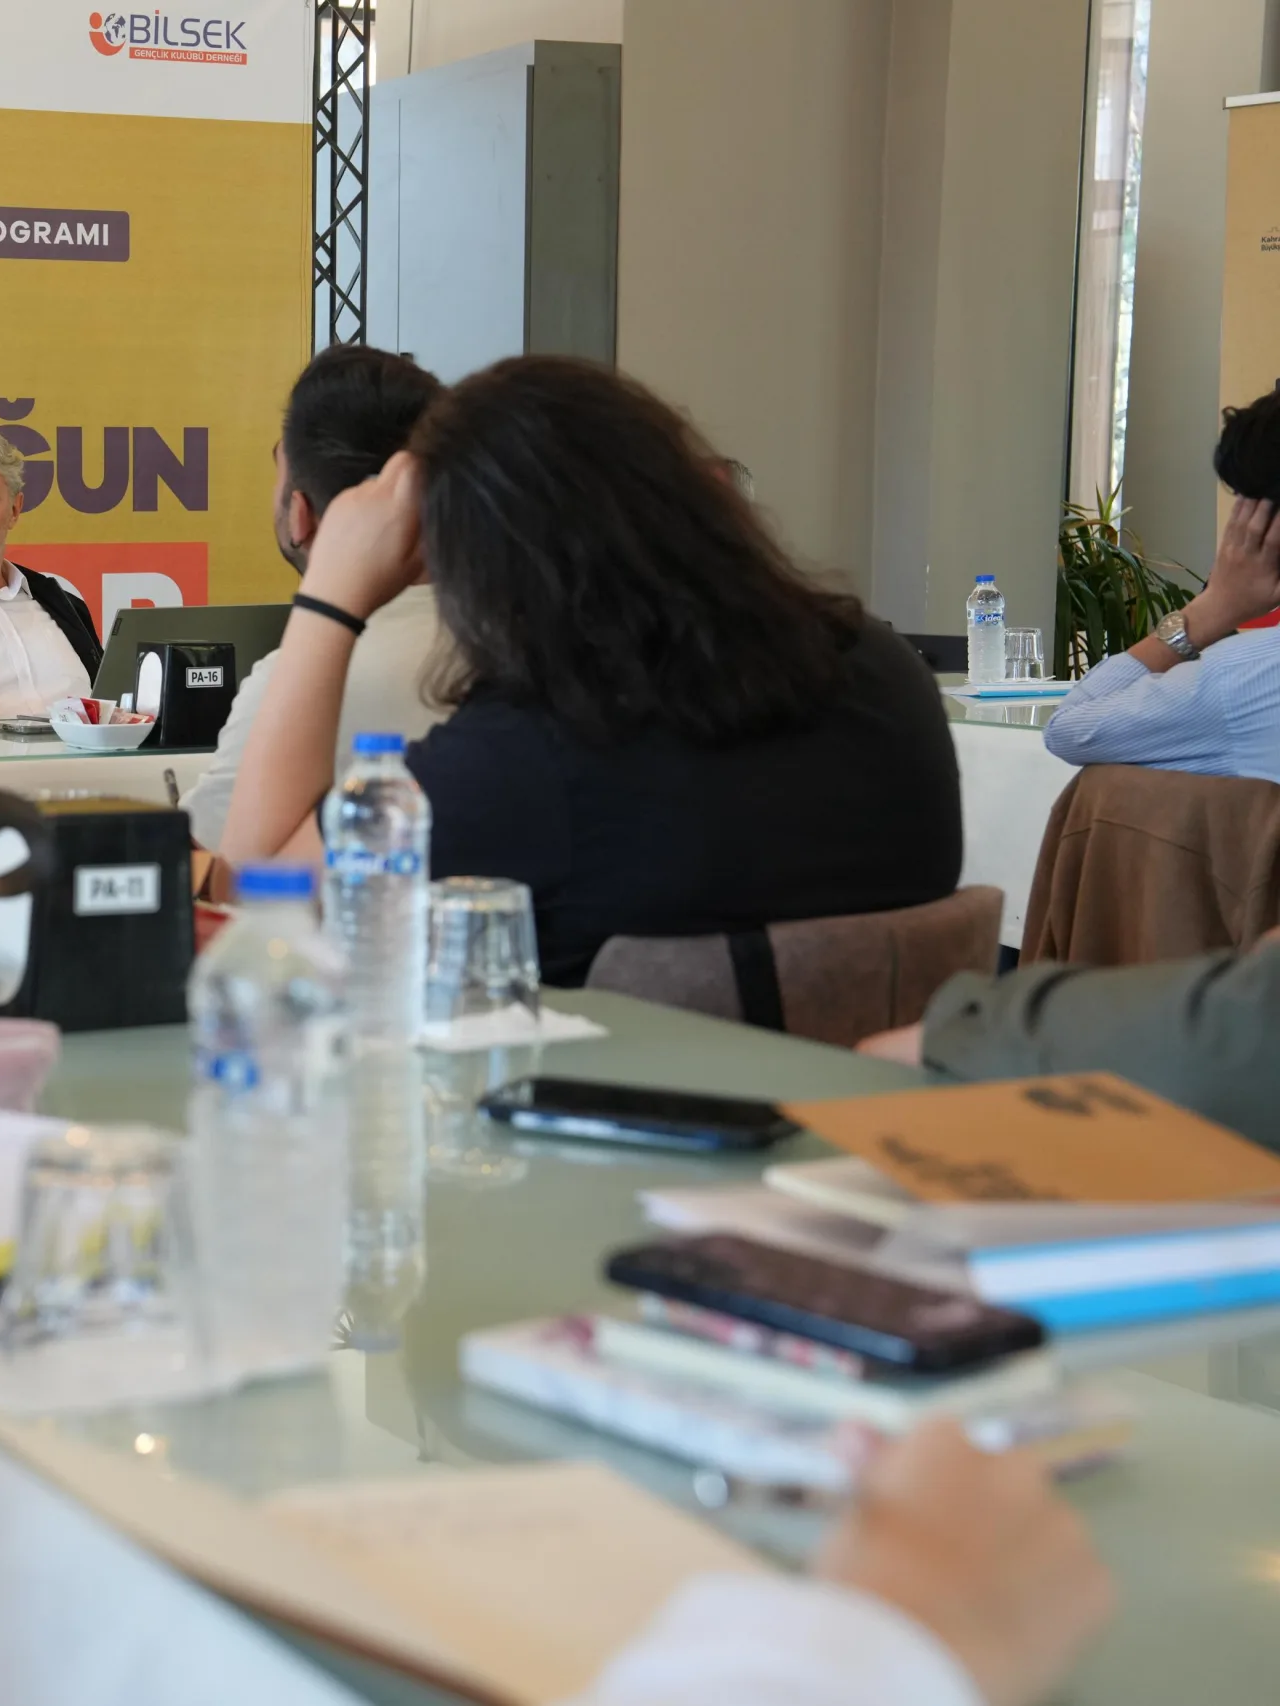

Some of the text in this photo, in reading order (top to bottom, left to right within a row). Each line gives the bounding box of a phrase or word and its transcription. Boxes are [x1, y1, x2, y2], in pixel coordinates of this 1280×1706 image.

[130, 9, 247, 50] BİLSEK
[134, 49, 243, 63] GENÇLİK KULÜBÜ DERNEĞİ
[191, 671, 218, 683] PA-16
